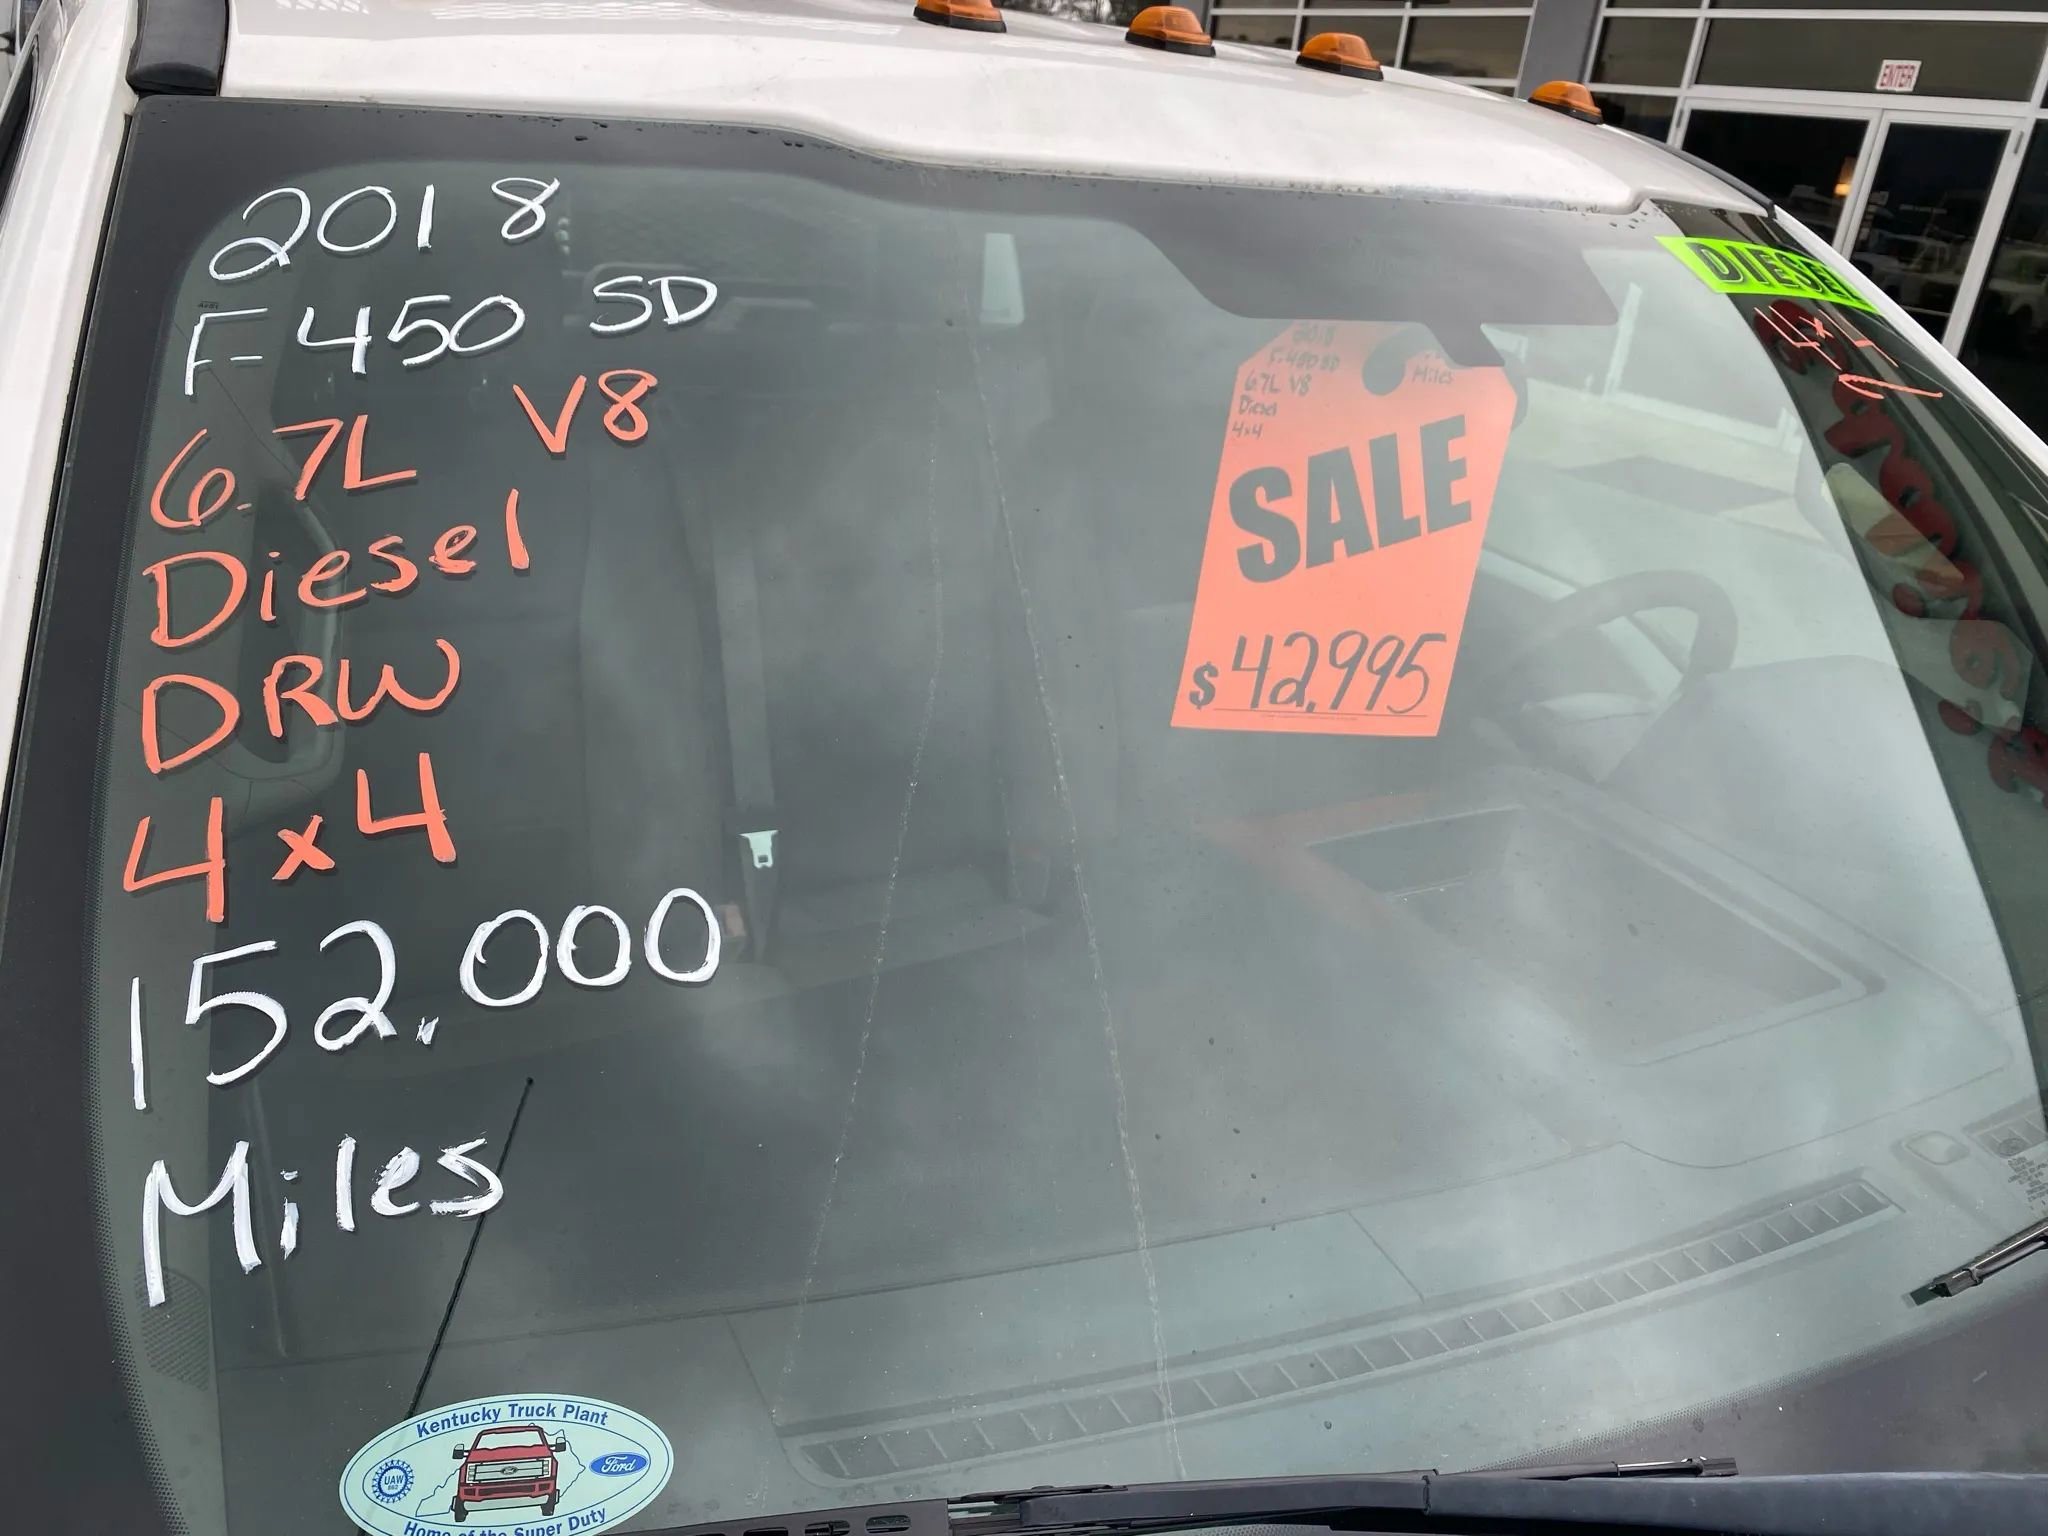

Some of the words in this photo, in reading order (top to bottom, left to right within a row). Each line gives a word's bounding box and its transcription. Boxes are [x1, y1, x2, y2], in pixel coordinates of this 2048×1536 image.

[208, 177, 560, 281] 2018
[1686, 241, 1866, 303] DIESEL
[589, 275, 719, 334] SD
[1238, 394, 1278, 417] Diesel
[1289, 374, 1313, 397] V8
[151, 414, 418, 529] 6.7L
[513, 368, 659, 455] V8
[1231, 421, 1263, 438] 4x4
[1229, 414, 1472, 583] SALE
[142, 487, 530, 647] Diesel
[142, 638, 461, 774] DRW
[142, 1132, 504, 1308] Miles
[416, 1404, 501, 1438] Kentucky
[508, 1403, 557, 1418] Truck
[562, 1404, 609, 1426] Plant
[384, 1475, 404, 1486] UAW
[601, 1456, 636, 1473] Ford
[568, 1508, 606, 1531] Duty
